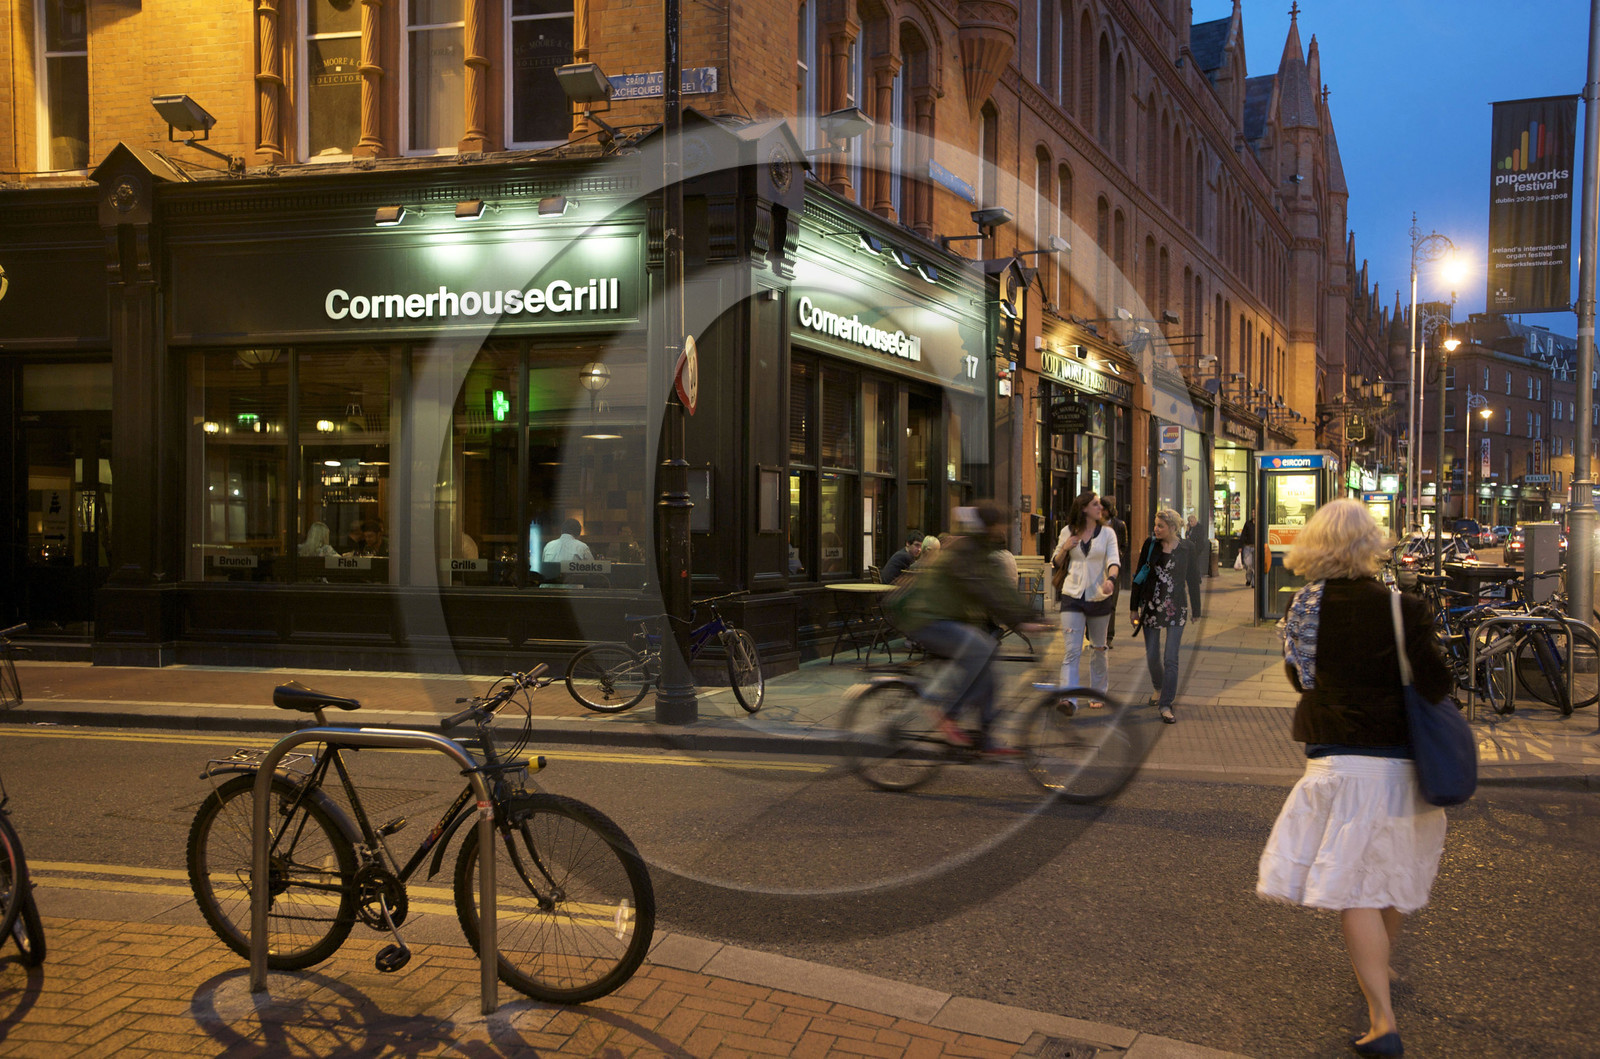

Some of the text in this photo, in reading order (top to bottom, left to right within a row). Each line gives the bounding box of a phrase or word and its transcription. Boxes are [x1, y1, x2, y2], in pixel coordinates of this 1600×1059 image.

[323, 57, 348, 67] MOORE
[646, 74, 656, 84] AN
[1495, 169, 1569, 187] pipeworks
[1514, 180, 1557, 193] festival
[1516, 195, 1535, 203] 20-29
[1535, 195, 1550, 203] june
[1523, 243, 1568, 252] international
[1506, 251, 1553, 261] organ festival
[1495, 259, 1563, 269] pipeworksfestival.com
[325, 277, 618, 321] CornerhouseGrill
[799, 296, 921, 362] CornerhouseGrill
[966, 354, 979, 380] 17
[1041, 351, 1059, 374] OOD
[1281, 458, 1311, 467] eircom
[219, 556, 252, 566] Brunch
[338, 558, 358, 567] Fish
[451, 560, 477, 570] Grills
[569, 561, 603, 572] Steaks
